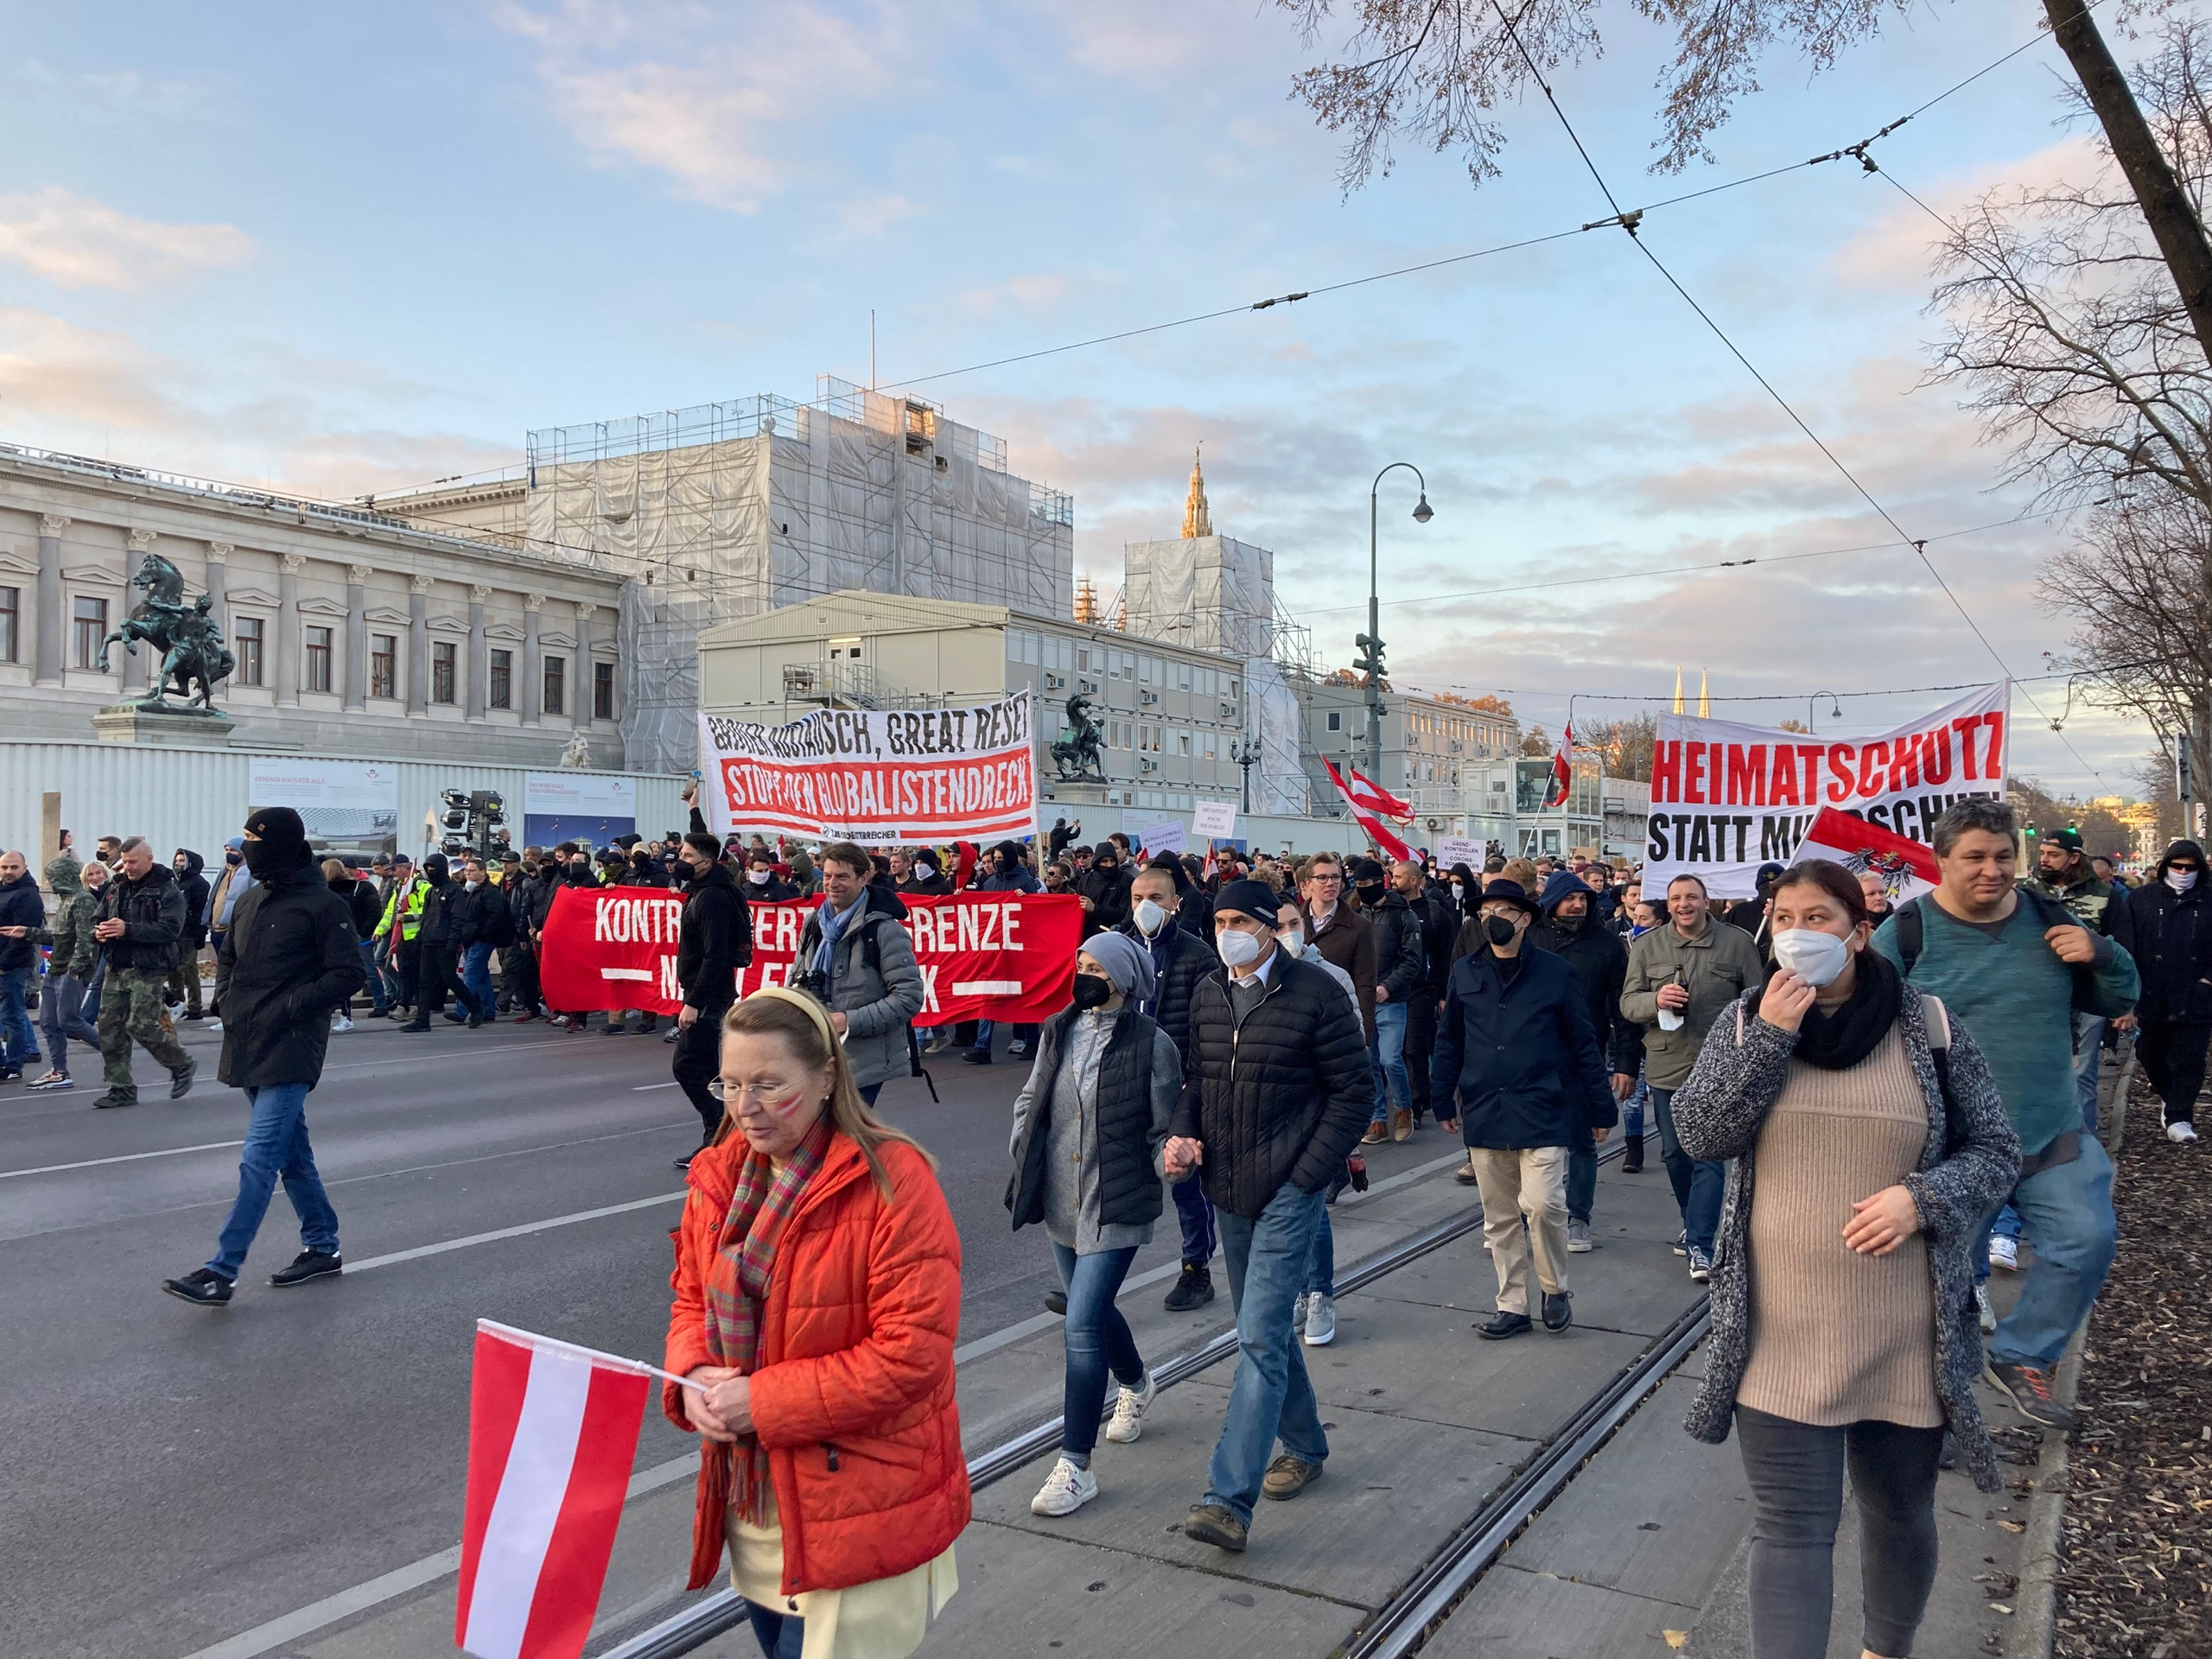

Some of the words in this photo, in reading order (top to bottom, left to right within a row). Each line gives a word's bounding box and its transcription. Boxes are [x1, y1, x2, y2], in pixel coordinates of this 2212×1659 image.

[768, 710, 880, 761] AUSTAUSCH,
[887, 710, 969, 755] GREAT
[974, 693, 1028, 750] RESET
[1651, 710, 2003, 807] HEIMATSCHUTZ
[783, 772, 818, 816] DEN
[818, 755, 1029, 818] GLOBALISTENDRECK
[1144, 830, 1181, 842] SCHALLENBERG
[1648, 812, 1753, 862] STATT
